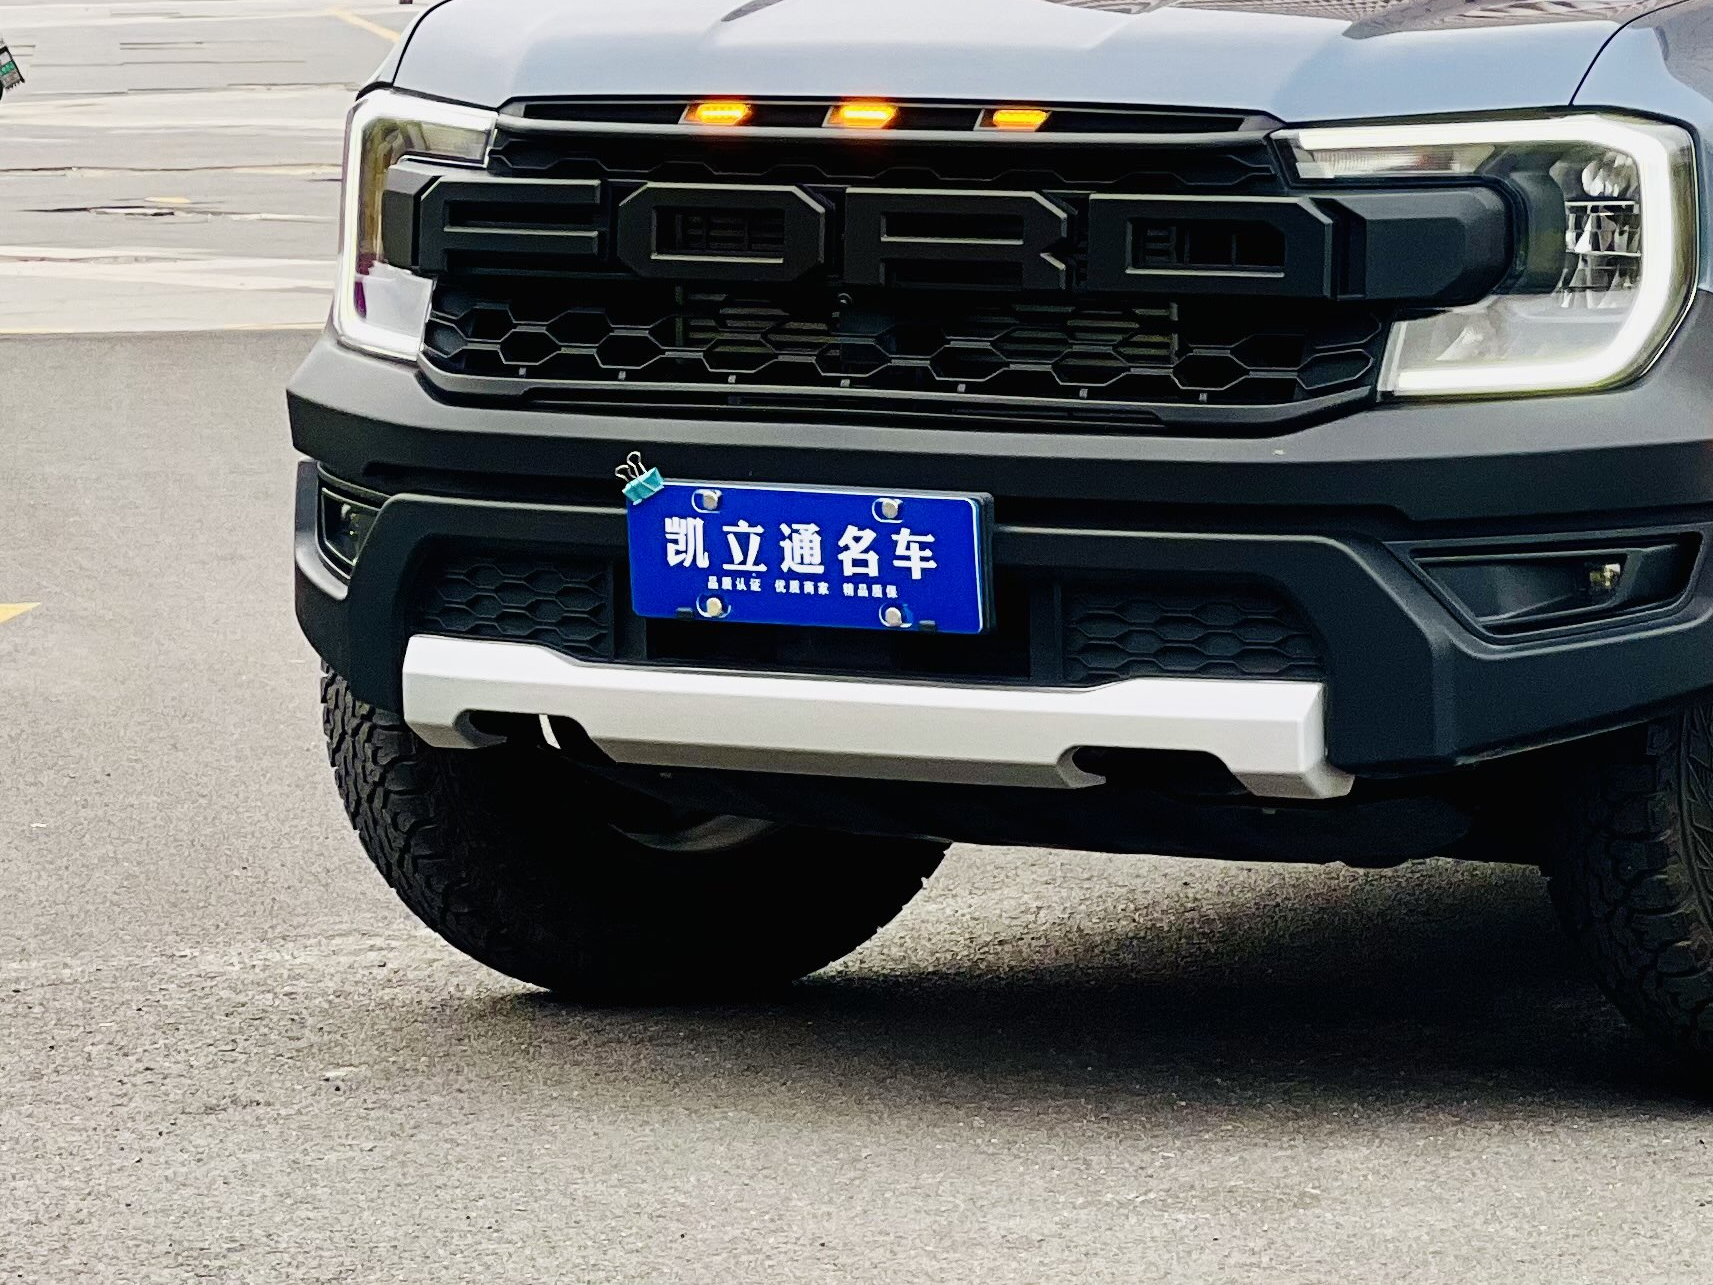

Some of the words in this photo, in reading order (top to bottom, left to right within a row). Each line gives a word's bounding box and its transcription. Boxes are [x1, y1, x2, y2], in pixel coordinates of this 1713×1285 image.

[420, 173, 1335, 301] FORD
[664, 516, 938, 581] 凯立通名车
